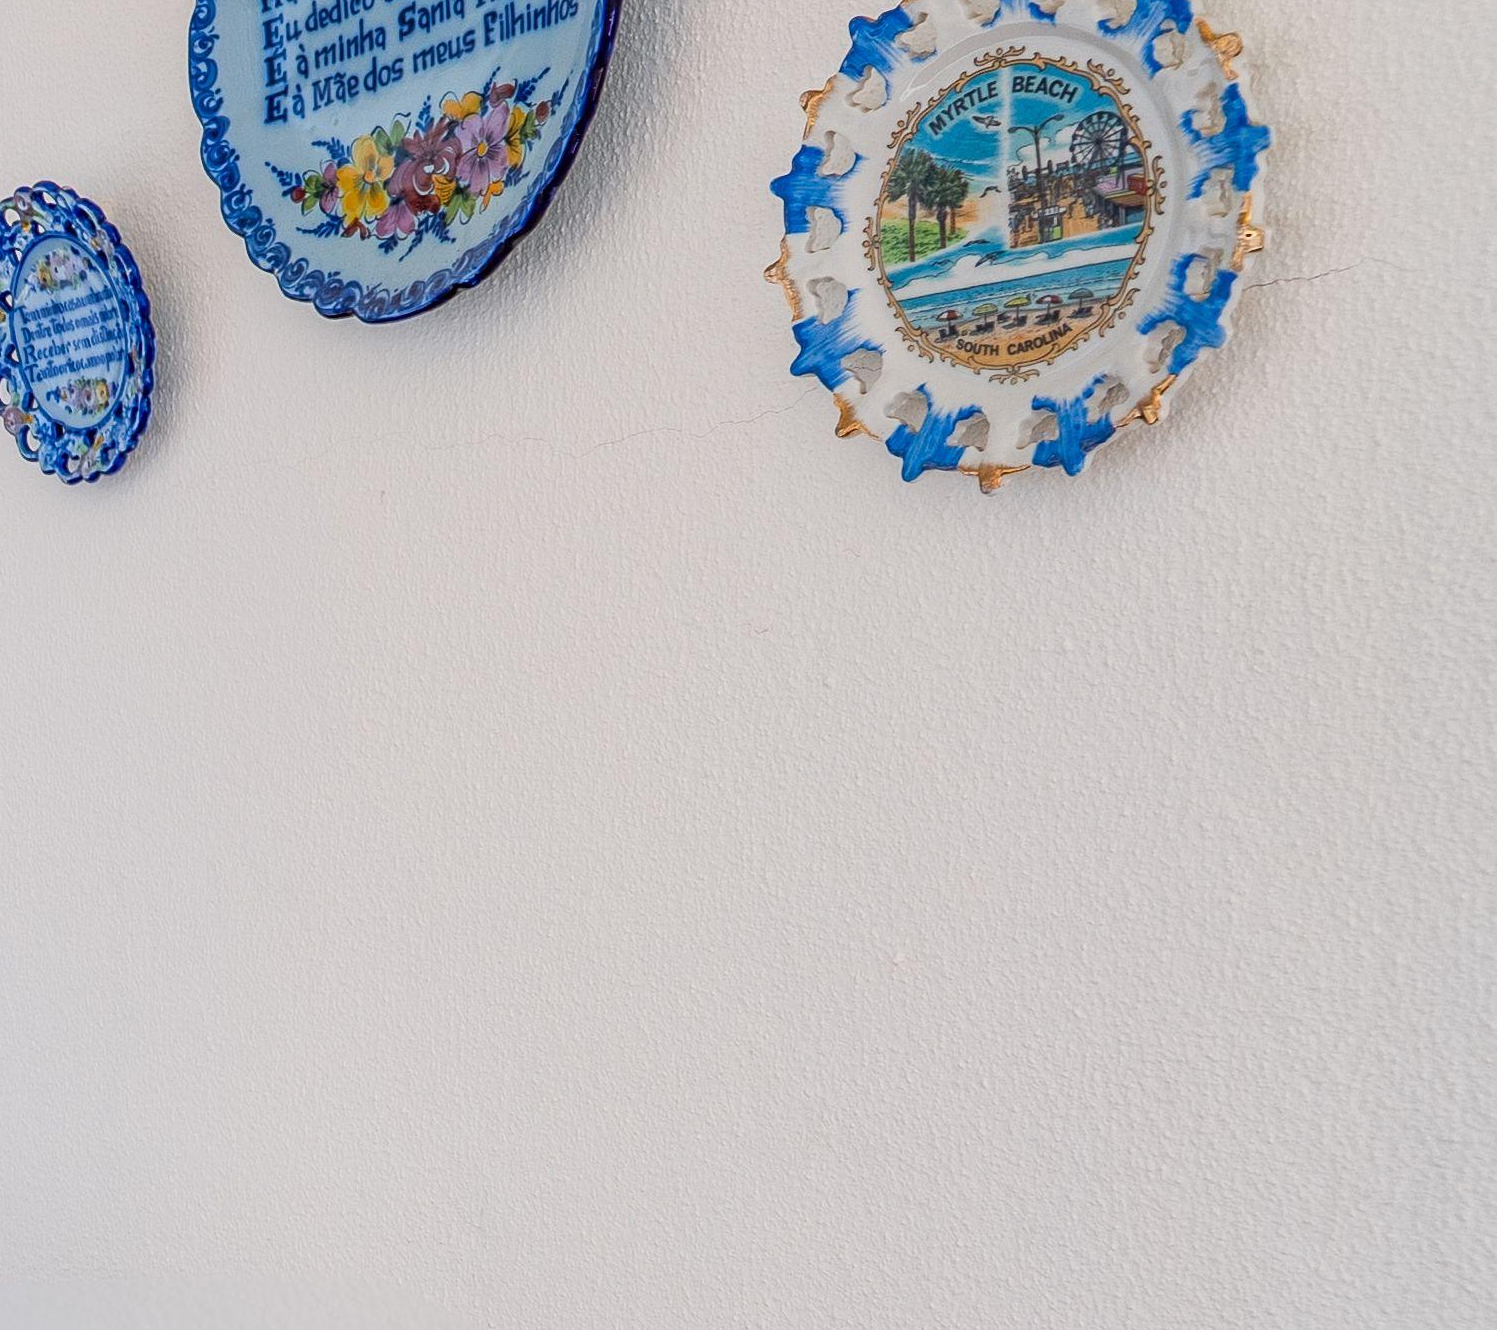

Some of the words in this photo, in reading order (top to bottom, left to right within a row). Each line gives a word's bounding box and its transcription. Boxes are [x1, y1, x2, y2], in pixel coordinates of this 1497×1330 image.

[261, 12, 303, 50] Eu
[314, 18, 387, 70] minha
[263, 83, 289, 125] E
[311, 72, 360, 112] Mãe
[362, 55, 405, 93] dos
[412, 29, 477, 74] meus
[927, 80, 999, 136] MYRTLE
[1011, 75, 1079, 104] BEACH
[955, 338, 1000, 357] SOUTH
[1006, 322, 1073, 356] CAROLINA
